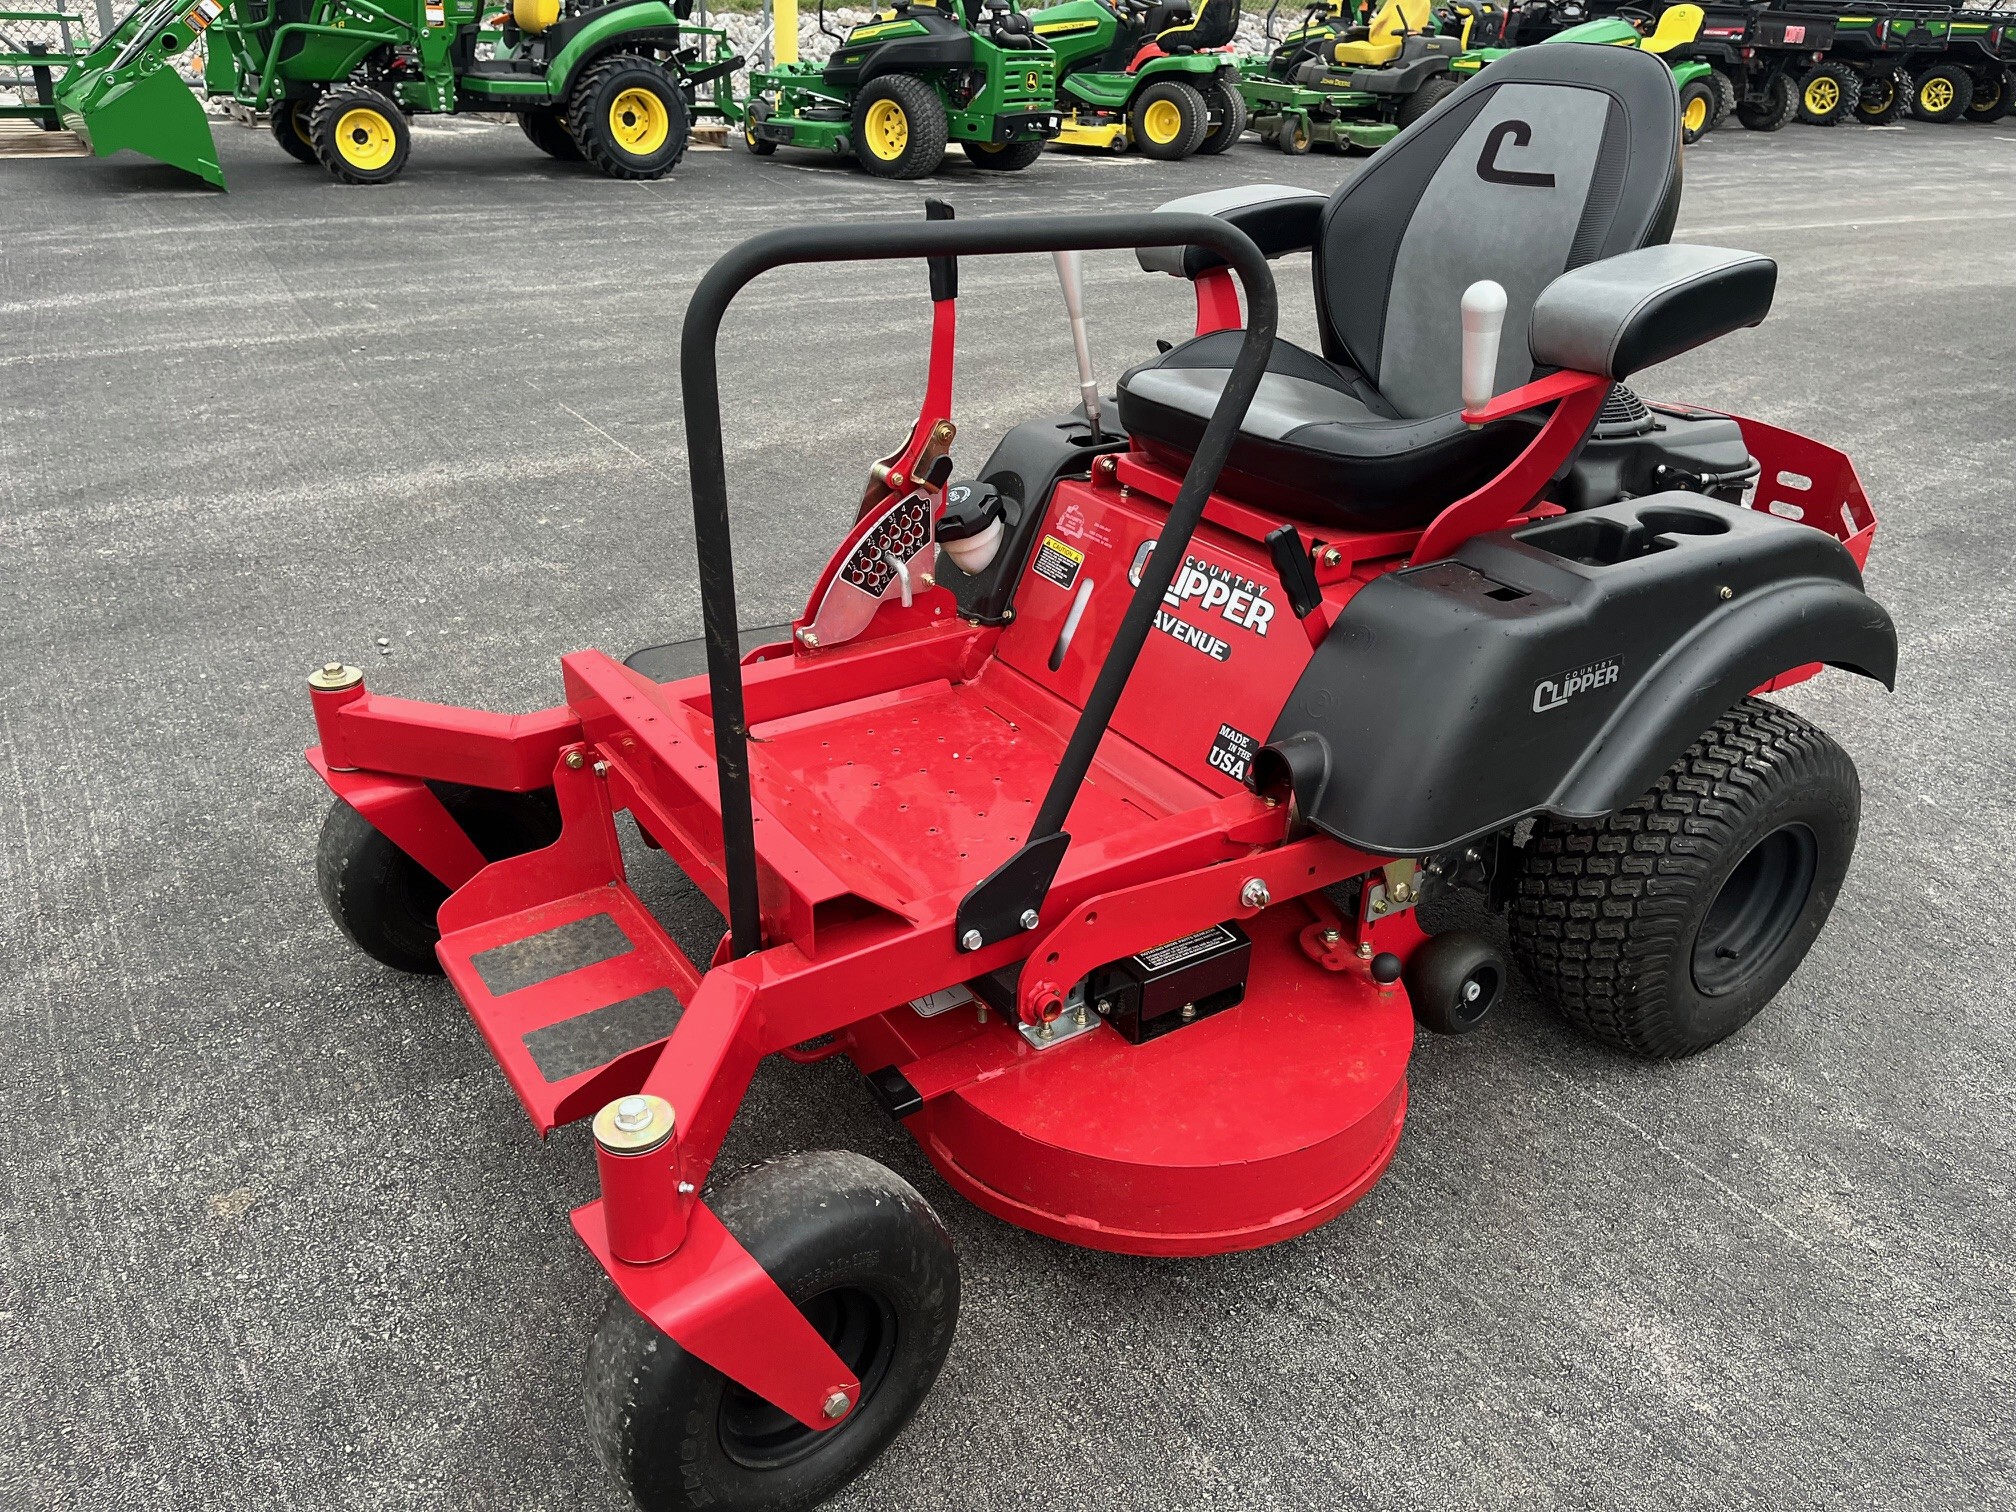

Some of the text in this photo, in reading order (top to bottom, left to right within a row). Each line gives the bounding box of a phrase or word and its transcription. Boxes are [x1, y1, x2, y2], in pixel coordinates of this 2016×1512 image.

[1320, 77, 1351, 88] JOHN DEERE
[1052, 541, 1073, 558] CAUTION
[1128, 540, 1275, 636] CIPPER
[1185, 555, 1269, 598] COUNTRY
[1152, 609, 1228, 662] AVENUE
[1565, 659, 1613, 681] COUNTRY
[1533, 665, 1619, 713] CLIPPER
[1219, 724, 1250, 749] MADE
[1209, 745, 1245, 781] USA
[1227, 742, 1252, 762] IN THE
